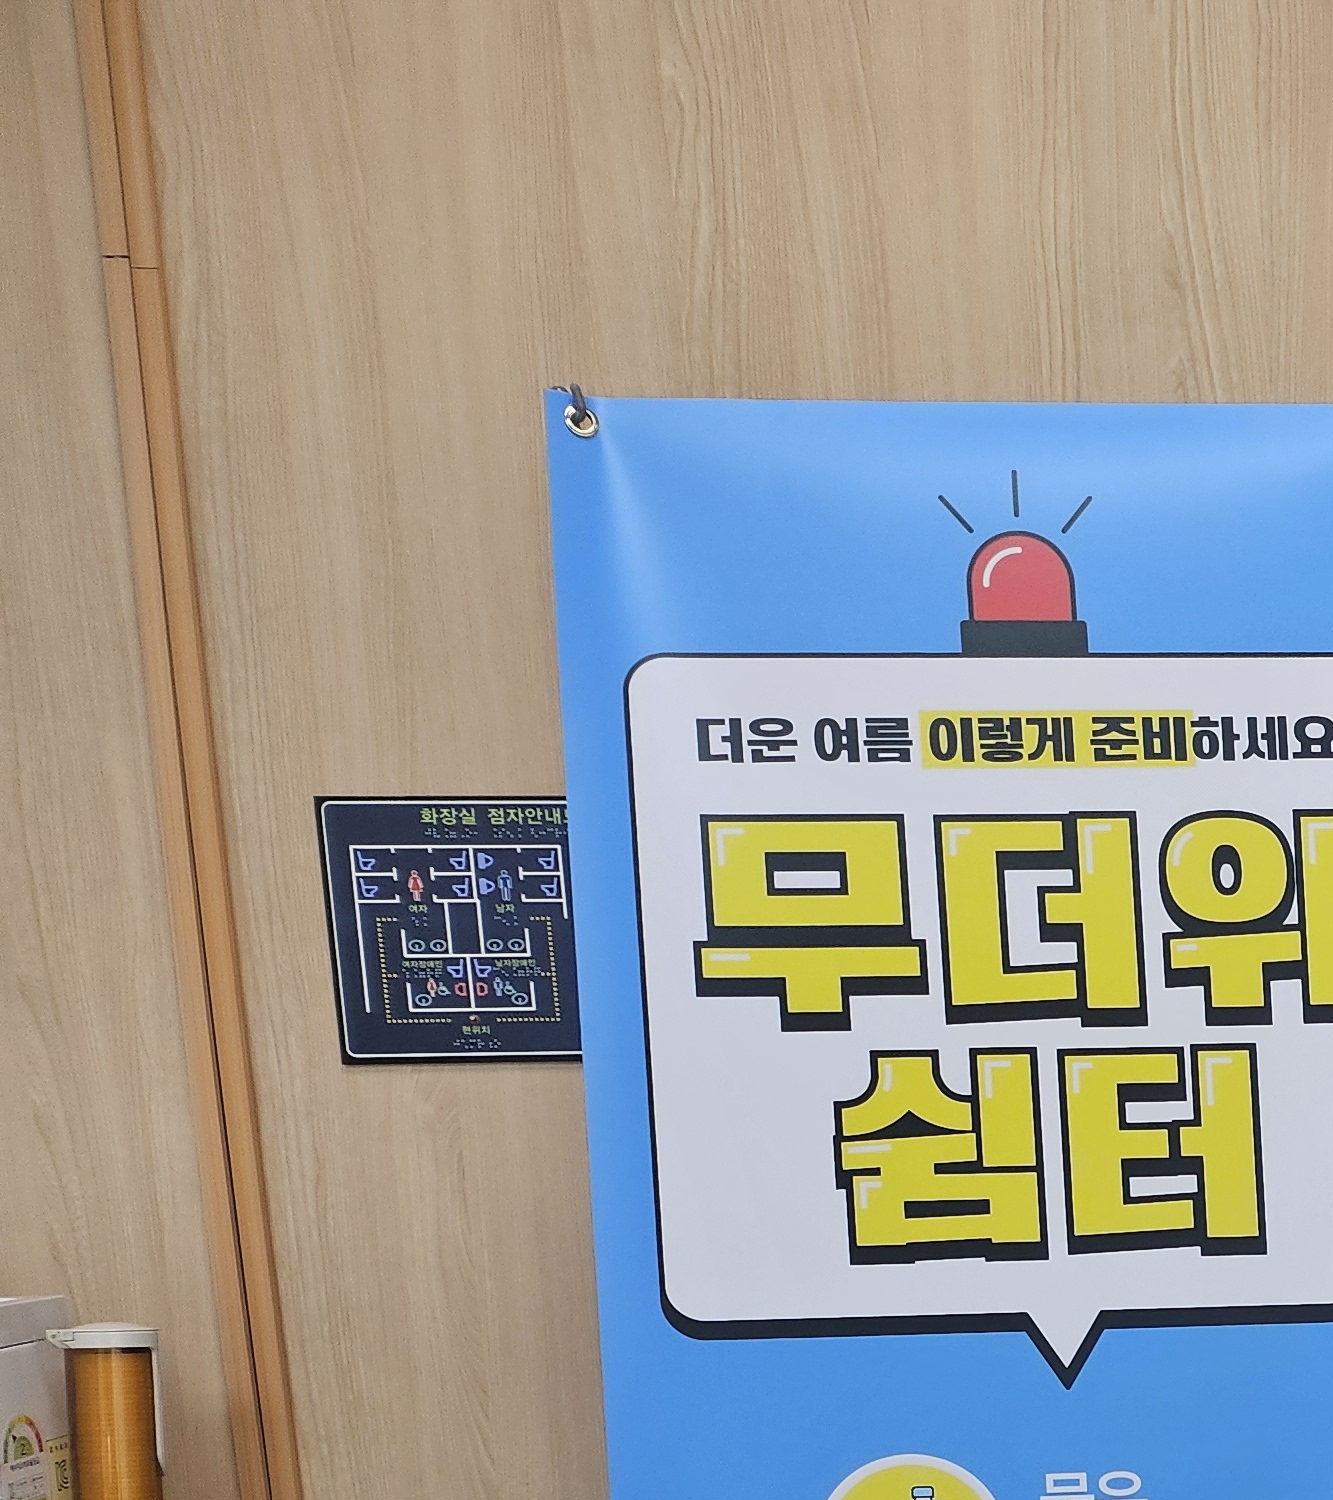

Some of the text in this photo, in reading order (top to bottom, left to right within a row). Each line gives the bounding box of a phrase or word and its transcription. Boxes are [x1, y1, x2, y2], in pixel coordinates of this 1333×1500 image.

[696, 718, 798, 764] 더운
[814, 717, 913, 764] 여름
[929, 717, 1075, 763] 이렇게
[420, 808, 477, 825] 화장실
[408, 904, 428, 913] 여자
[833, 1043, 1267, 1265] 쉼터
